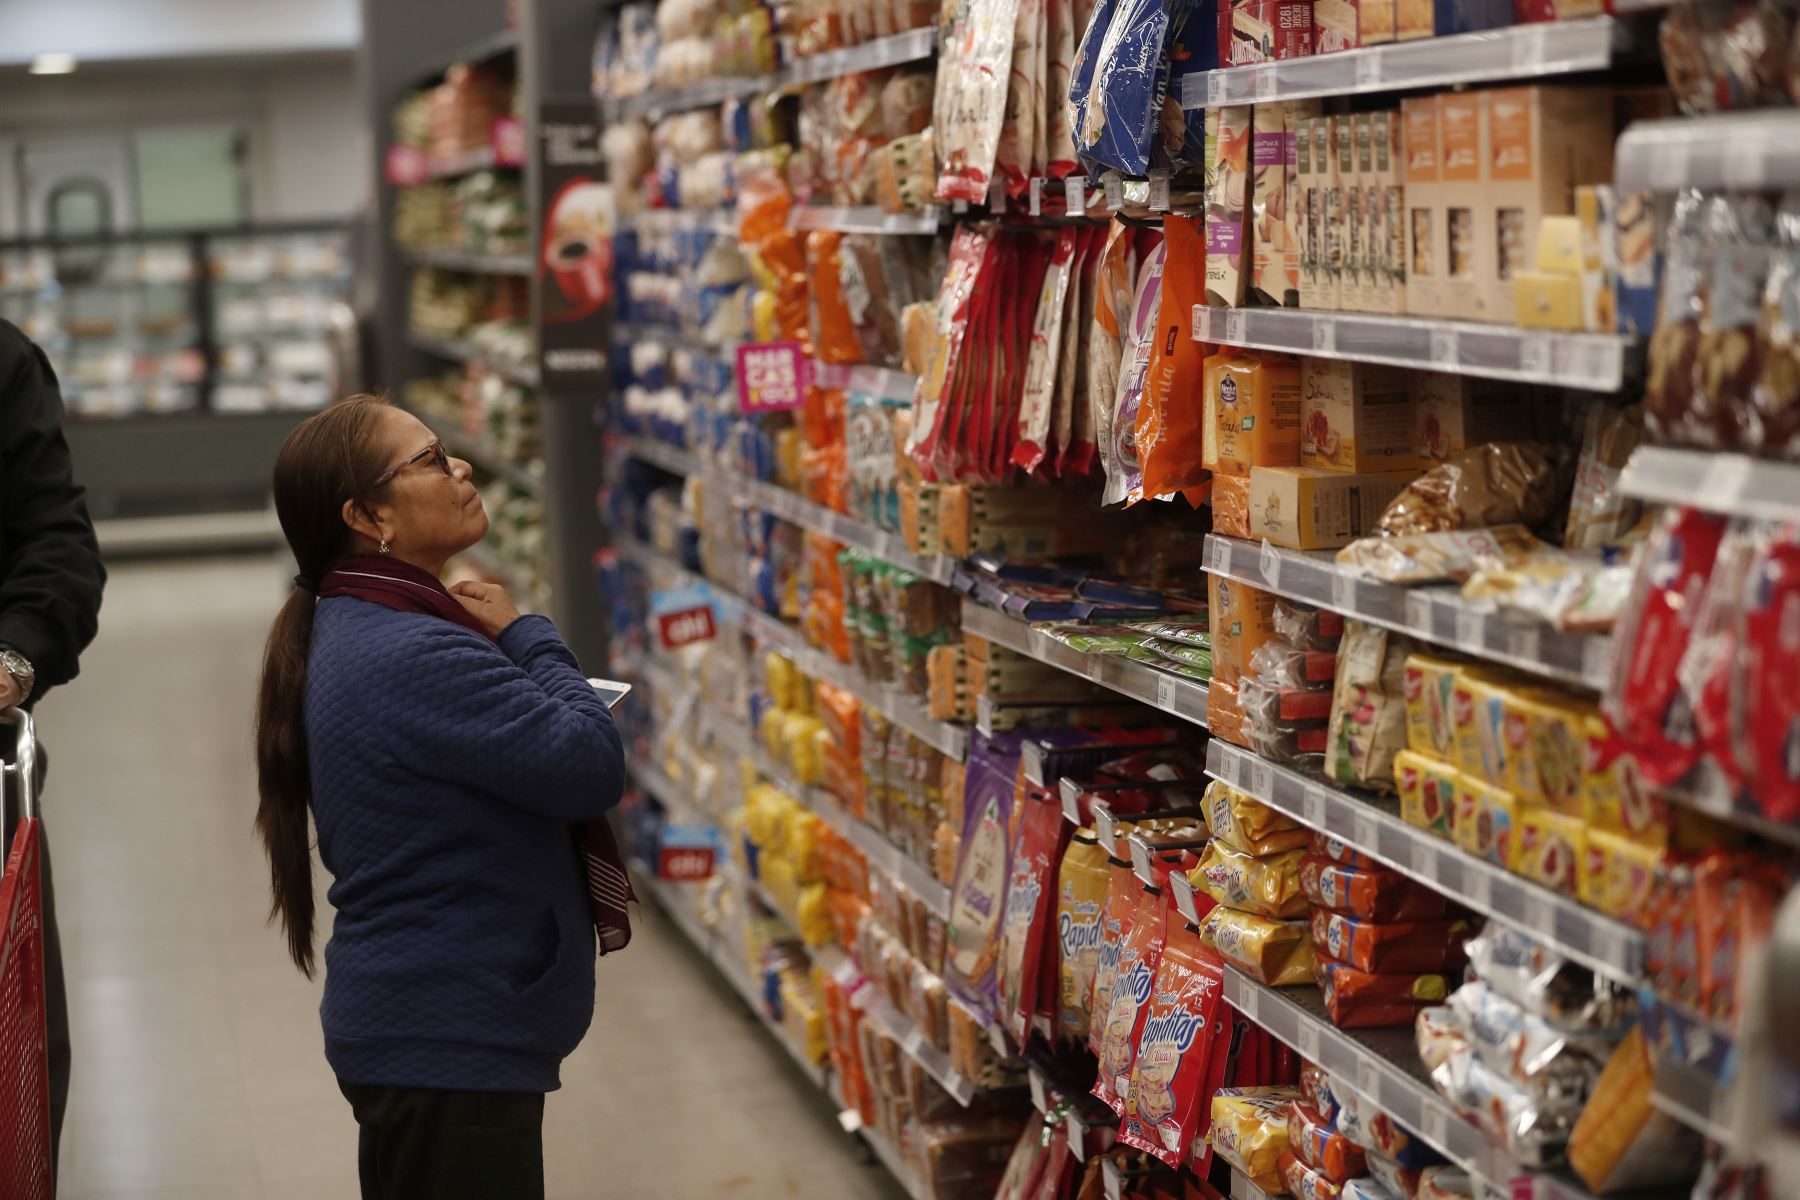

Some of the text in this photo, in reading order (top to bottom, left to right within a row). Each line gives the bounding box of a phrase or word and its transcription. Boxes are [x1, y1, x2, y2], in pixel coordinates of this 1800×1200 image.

[1280, 5, 1292, 29] 1920
[1292, 4, 1301, 28] DESDE
[1193, 996, 1203, 1008] 12
